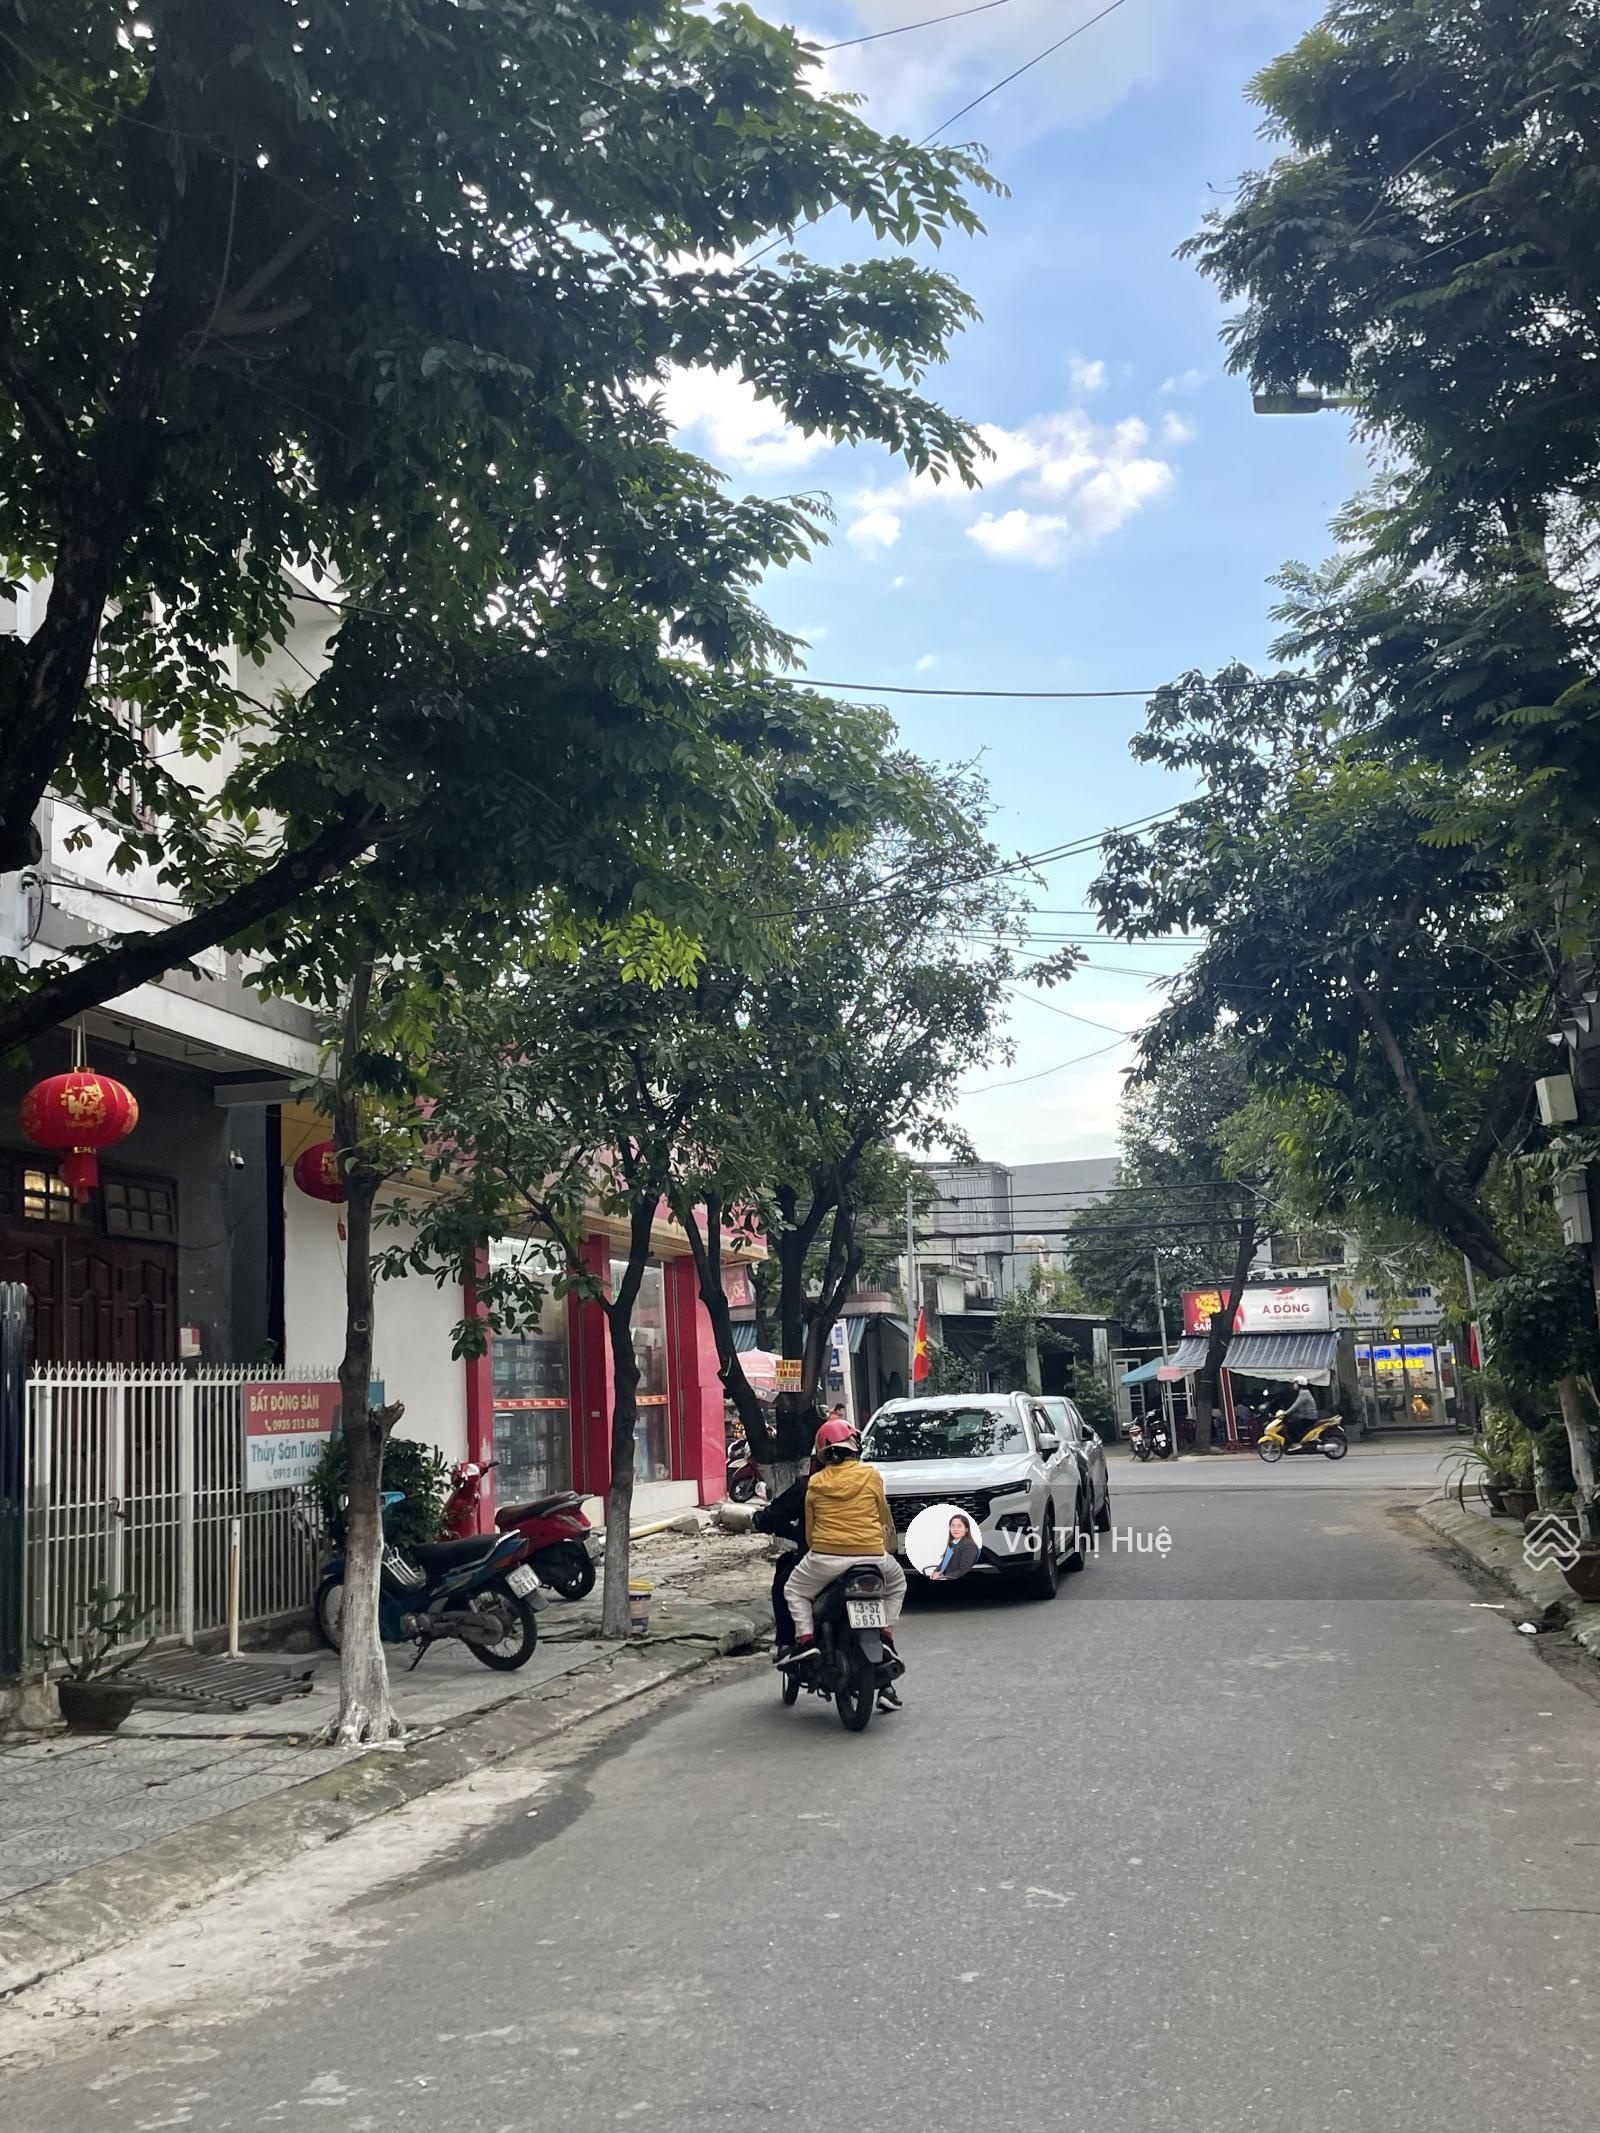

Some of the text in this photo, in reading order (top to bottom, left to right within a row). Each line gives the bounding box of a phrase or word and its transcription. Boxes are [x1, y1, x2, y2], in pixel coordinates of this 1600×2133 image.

[1376, 1359, 1424, 1369] STORE
[250, 1388, 319, 1416] BẤT ĐỘNG SẢN
[251, 1441, 275, 1465] Thủy
[278, 1439, 297, 1460] Sản
[855, 1614, 882, 1626] 5651
